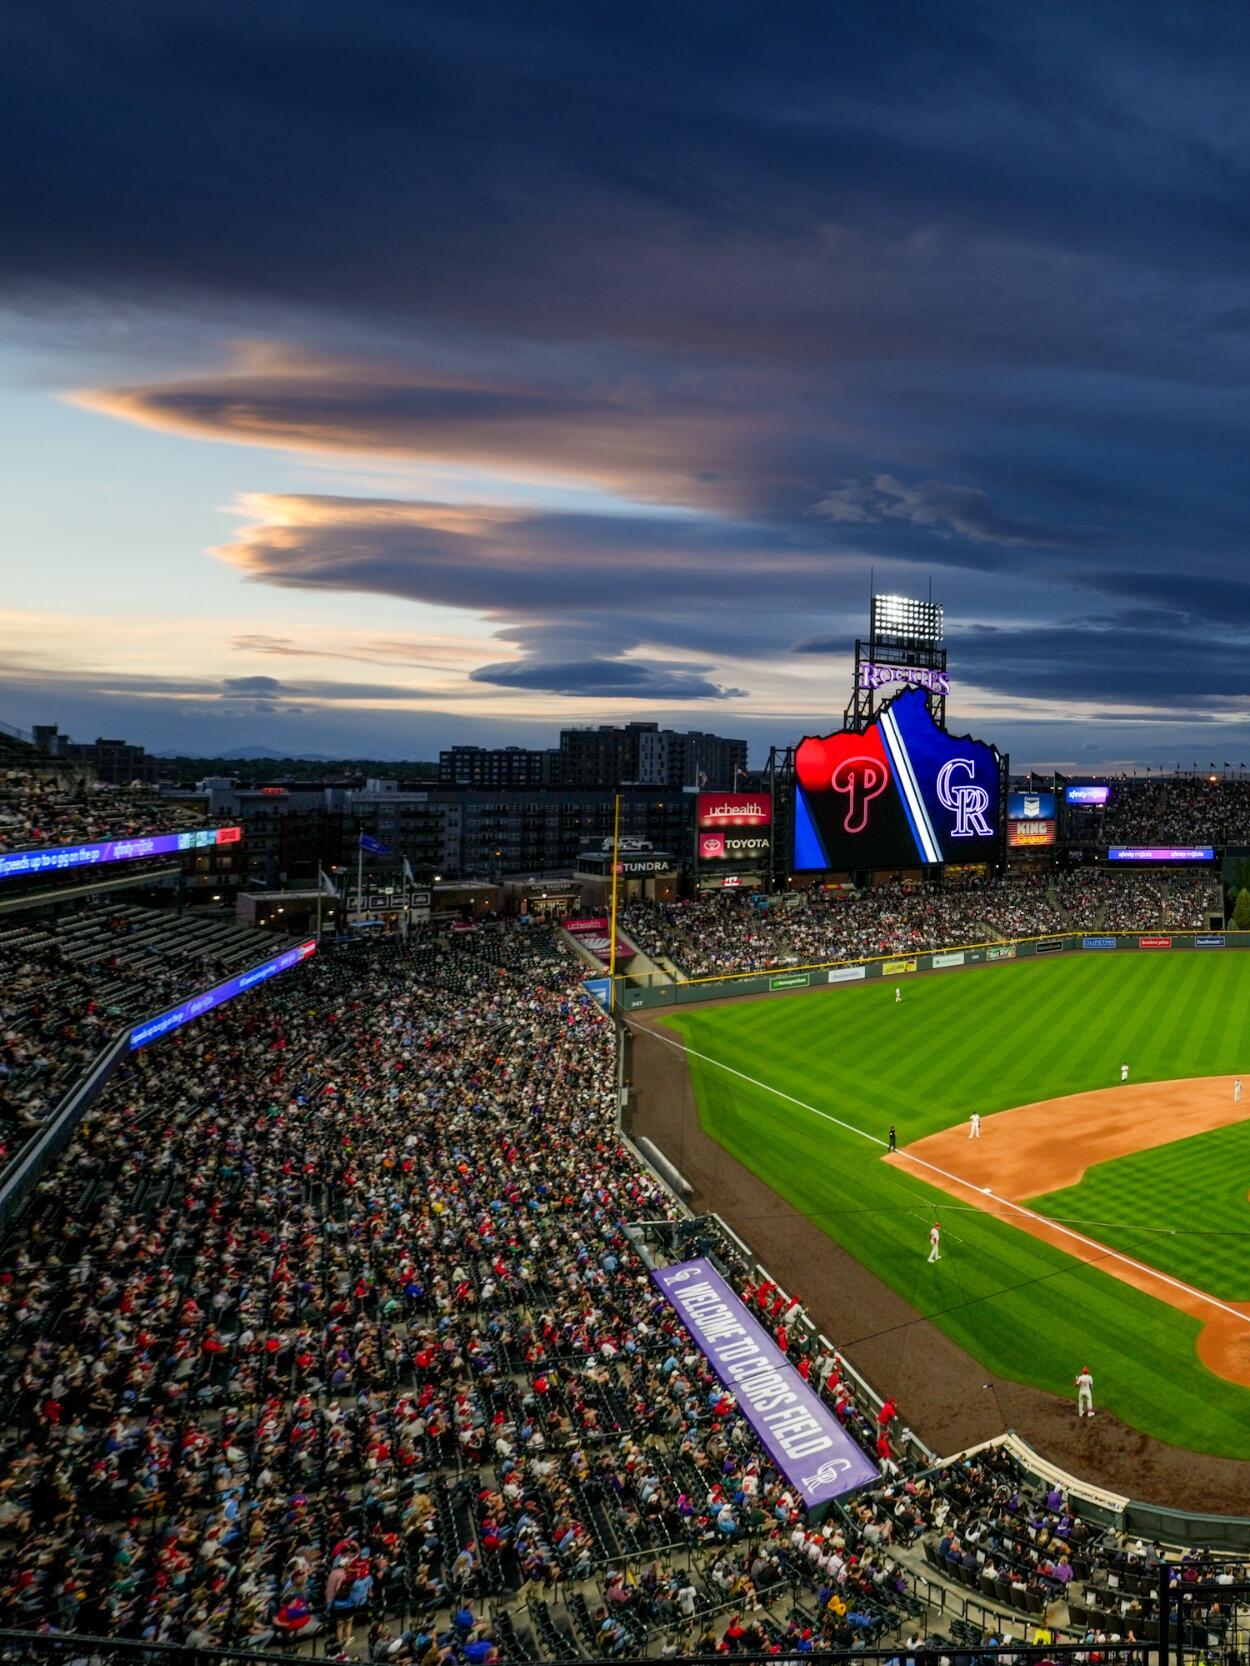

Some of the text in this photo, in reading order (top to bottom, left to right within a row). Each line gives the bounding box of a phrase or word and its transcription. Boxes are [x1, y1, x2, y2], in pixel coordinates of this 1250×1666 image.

[861, 664, 950, 695] ROCKIES
[832, 756, 888, 833] P
[937, 758, 993, 836] CR
[709, 802, 762, 816] uchealth
[1017, 822, 1047, 834] KING
[725, 839, 769, 849] TOYOTA
[624, 861, 669, 872] TUNDRA
[674, 1281, 834, 1460] WELCOME TO COORS FIELD
